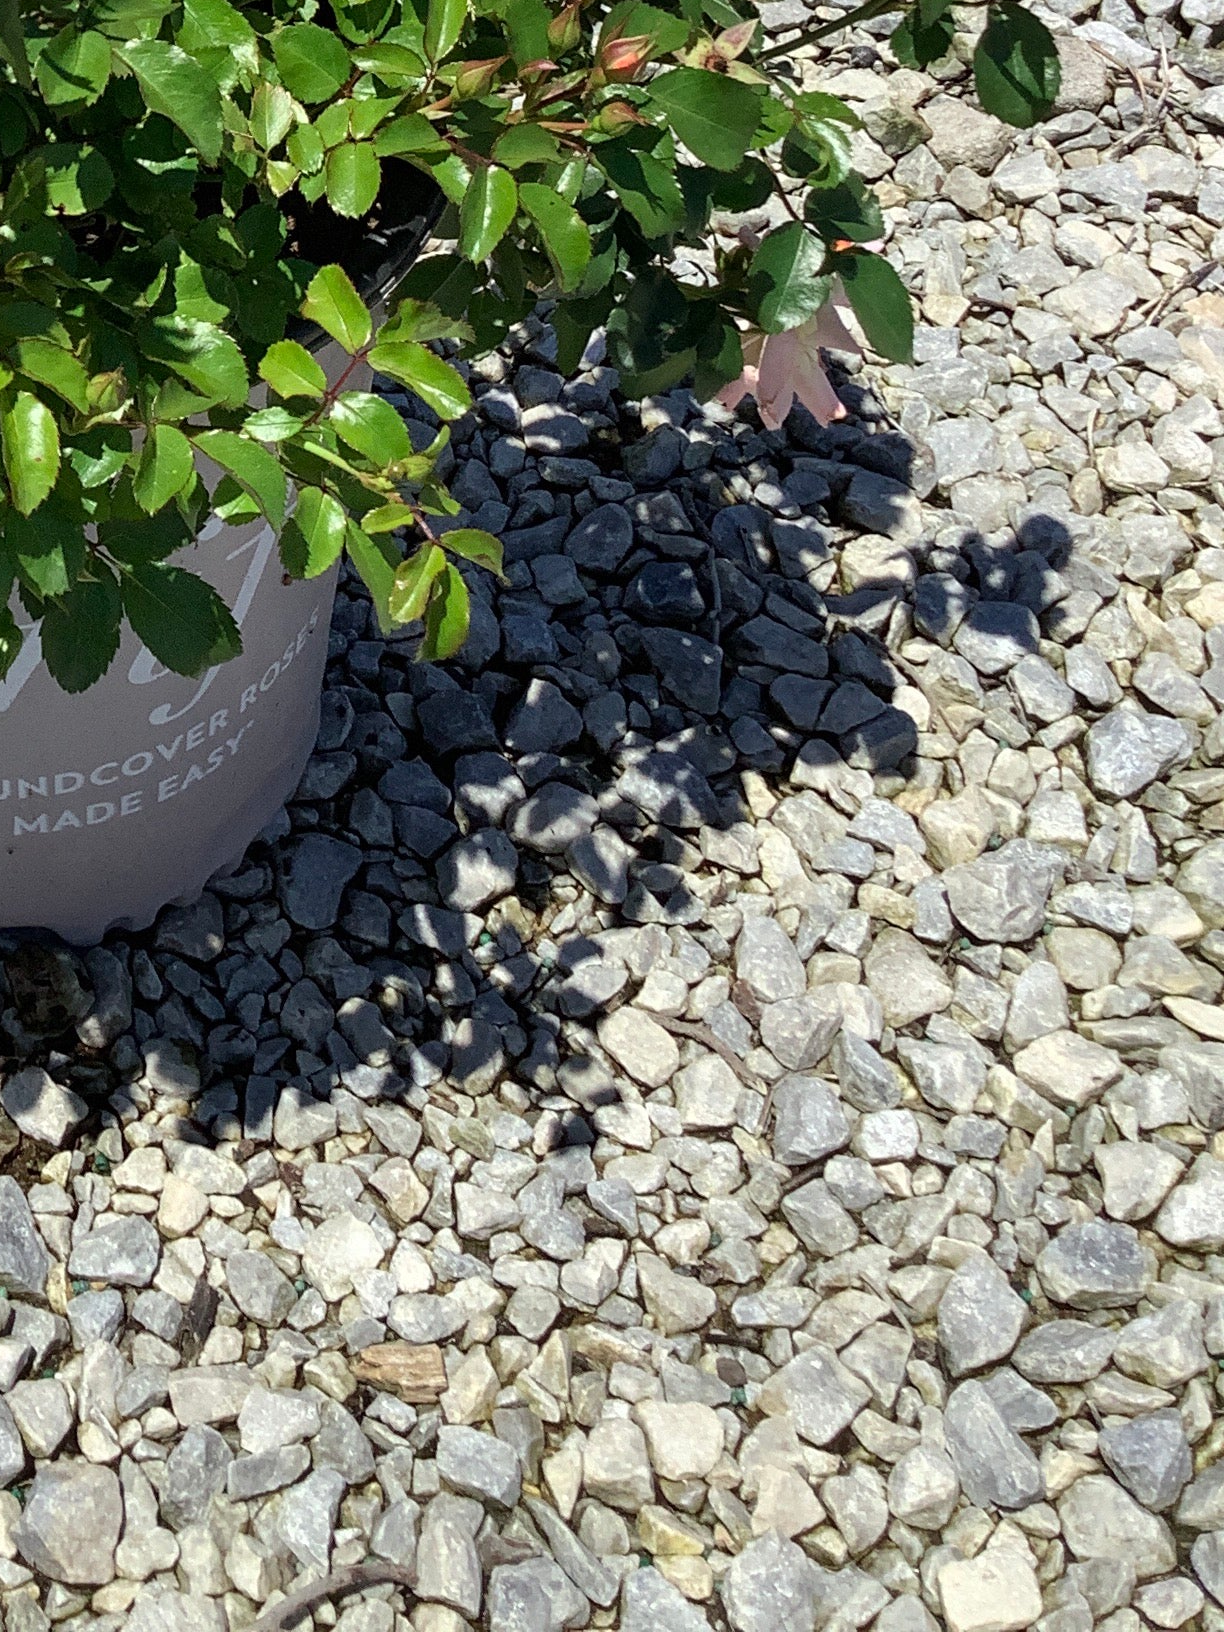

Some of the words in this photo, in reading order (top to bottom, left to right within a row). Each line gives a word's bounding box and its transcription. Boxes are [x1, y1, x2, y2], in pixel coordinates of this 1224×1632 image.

[239, 603, 318, 713] ROSES
[13, 791, 144, 837] MADE
[157, 725, 250, 803] EASY
